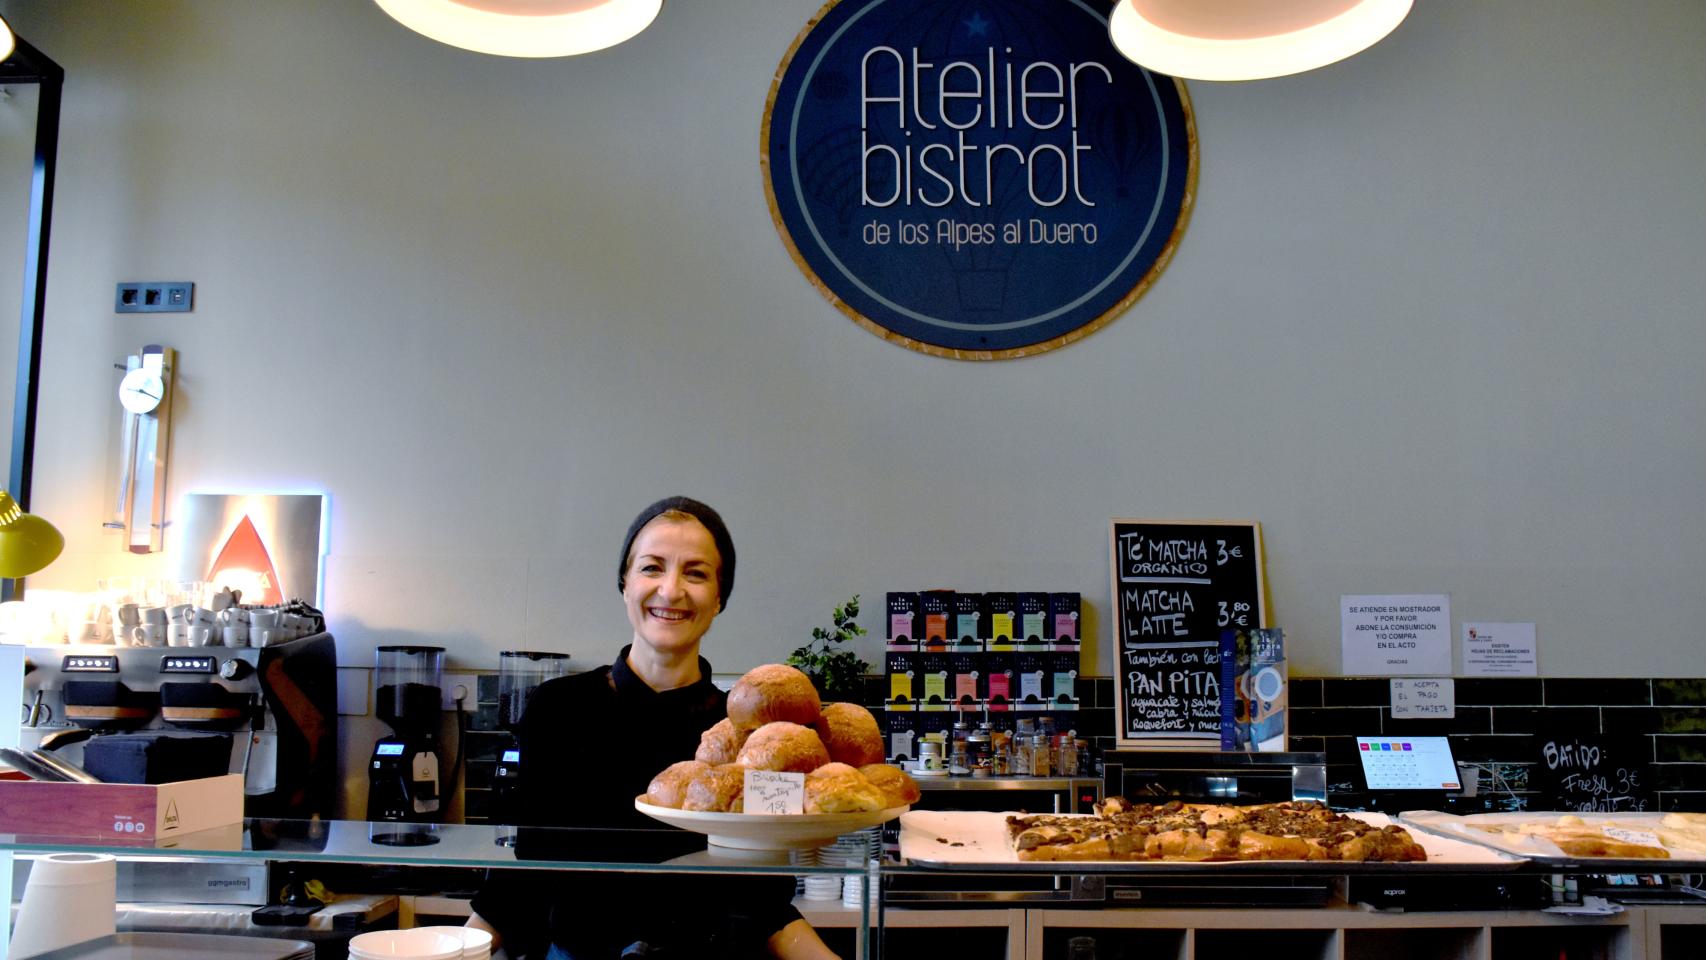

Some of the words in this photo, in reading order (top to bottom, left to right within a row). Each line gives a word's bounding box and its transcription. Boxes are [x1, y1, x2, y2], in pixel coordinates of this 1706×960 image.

[860, 45, 1113, 130] Atelier
[861, 130, 1096, 207] bistrot
[863, 219, 891, 245] de
[899, 219, 929, 245] los
[937, 219, 996, 251] Alpes
[1003, 219, 1021, 244] al
[1030, 219, 1097, 245] Duero
[1119, 531, 1144, 561] Té
[1149, 539, 1208, 563] MATCHA
[1126, 589, 1195, 612] MATCHA
[1128, 613, 1189, 636] LATTE
[1181, 652, 1199, 664] con
[1128, 671, 1163, 696] PAN
[1131, 695, 1180, 714] aguacate
[1183, 698, 1189, 711] y
[1146, 708, 1179, 719] cabra
[1183, 710, 1189, 720] y
[1189, 721, 1195, 732] y
